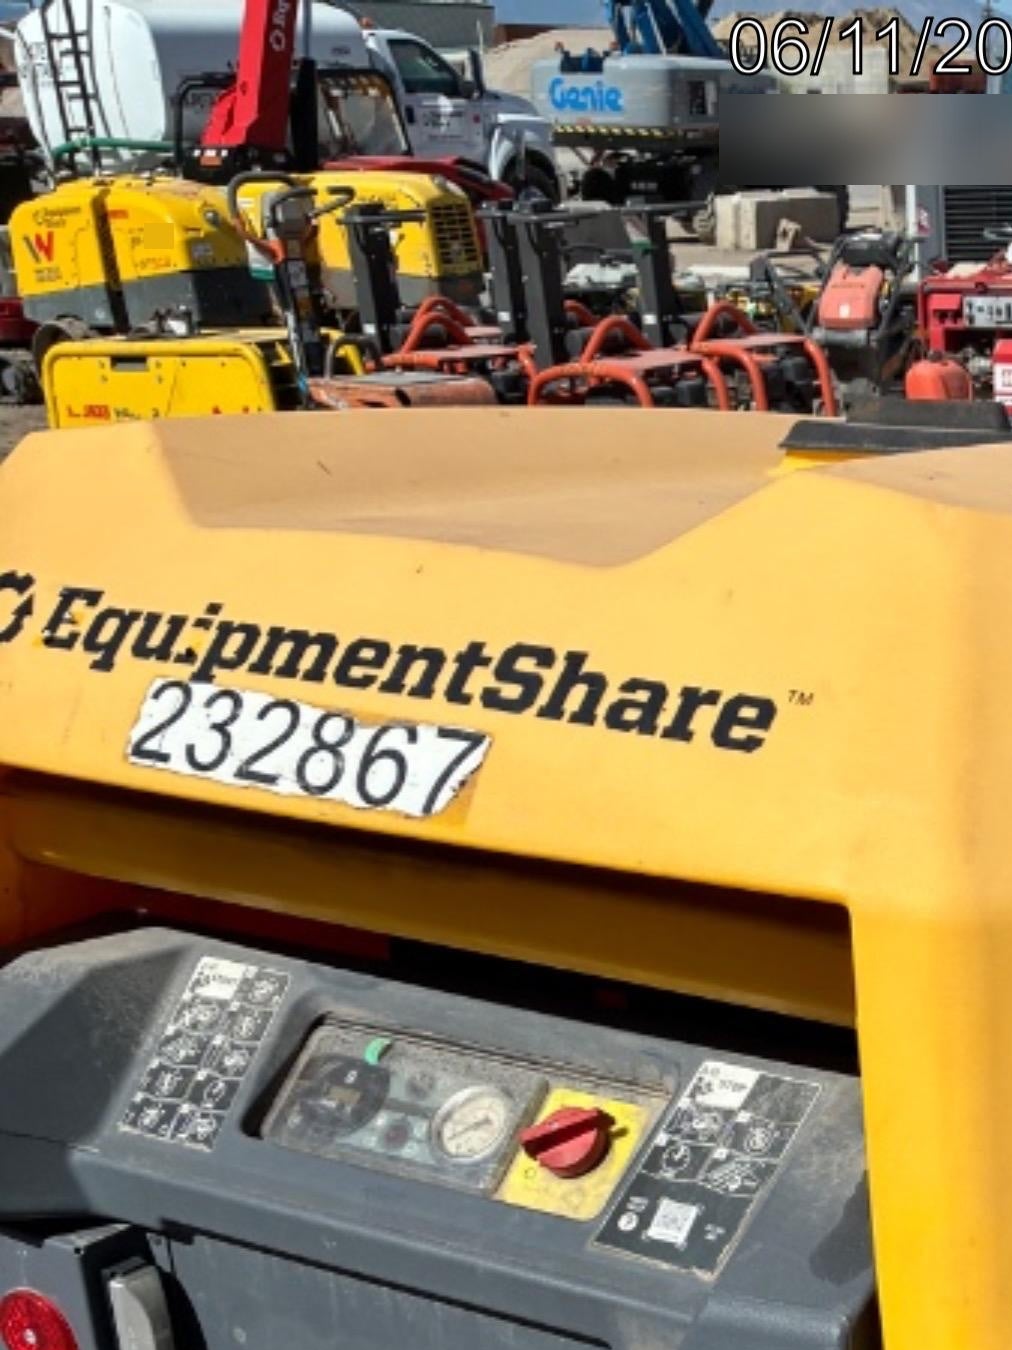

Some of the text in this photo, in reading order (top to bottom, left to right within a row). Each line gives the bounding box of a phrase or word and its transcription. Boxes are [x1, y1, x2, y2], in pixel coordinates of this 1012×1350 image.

[549, 77, 625, 113] Genie
[42, 586, 777, 753] EquipmentShare
[131, 679, 488, 814] 232867
